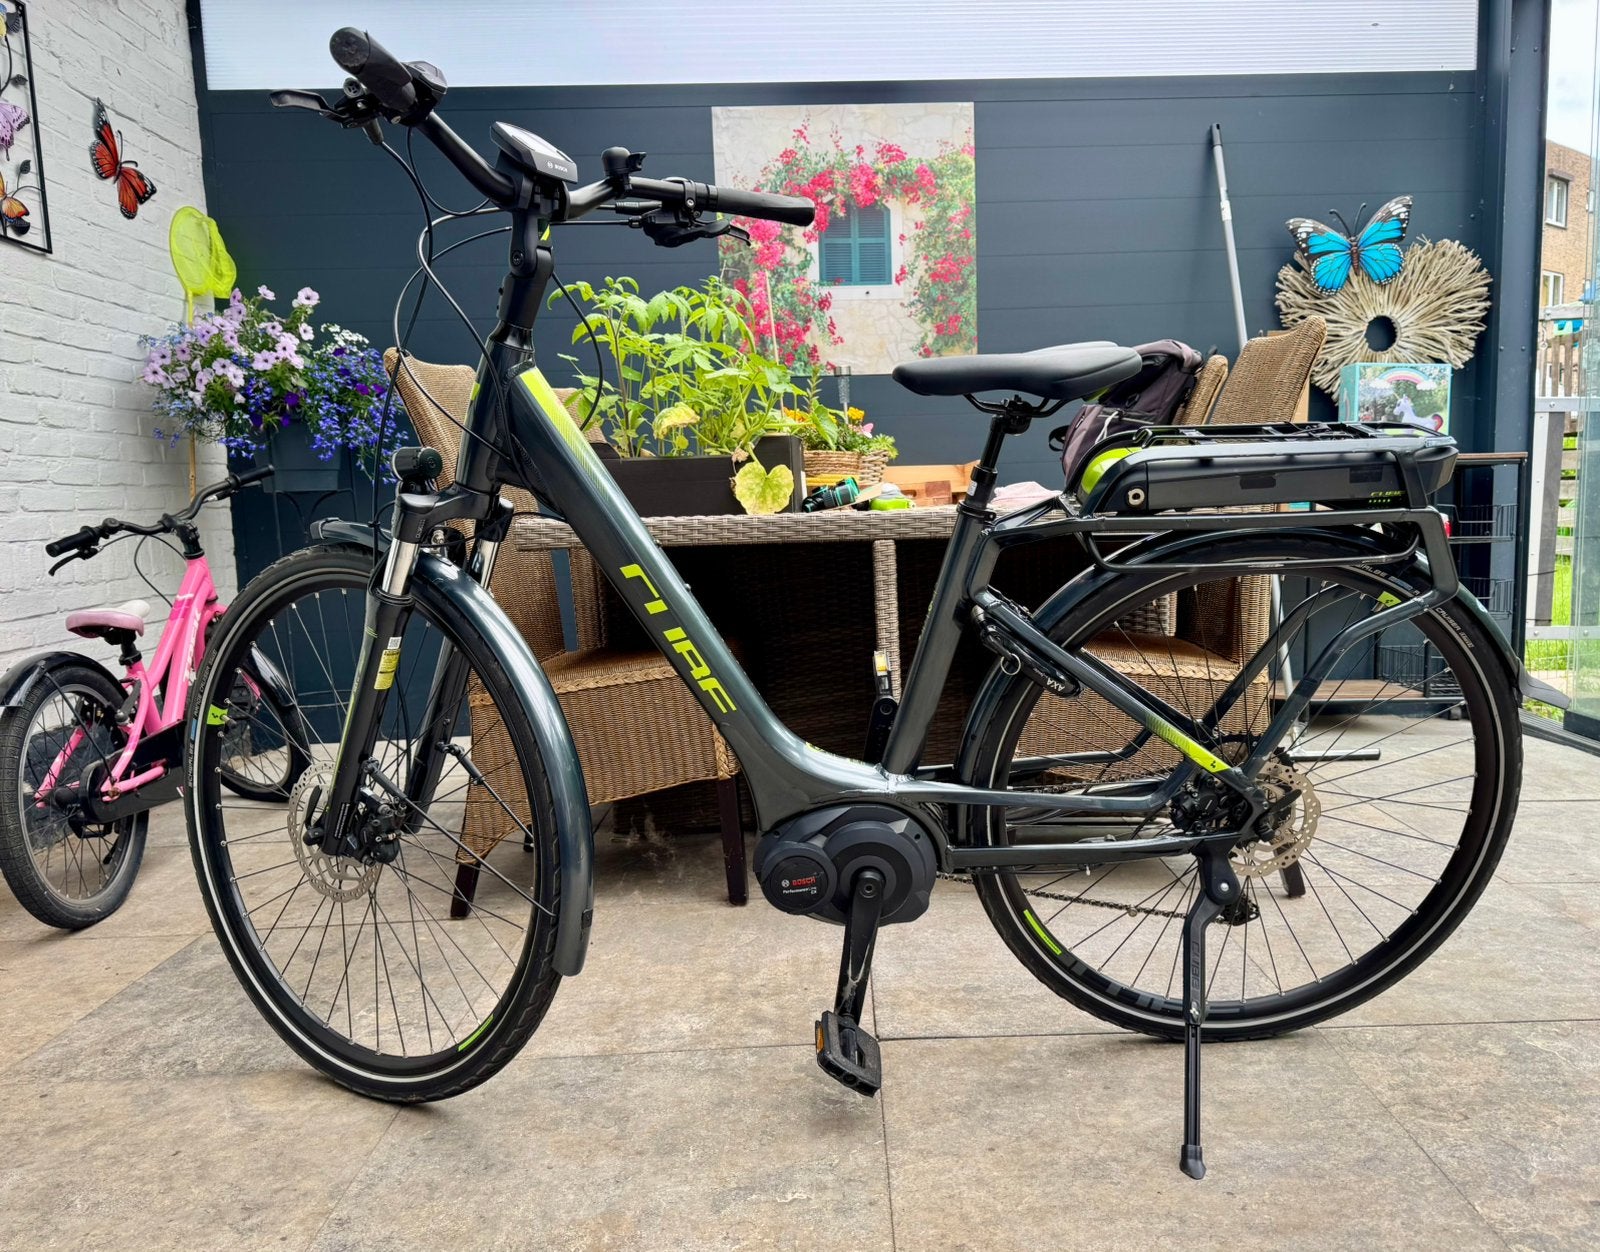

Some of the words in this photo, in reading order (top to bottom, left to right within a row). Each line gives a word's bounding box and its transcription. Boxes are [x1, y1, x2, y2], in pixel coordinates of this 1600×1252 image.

[1046, 677, 1066, 691] AXA
[185, 743, 195, 788] SCHWALBE
[792, 876, 816, 886] BOSCH
[1191, 941, 1200, 989] CUBE
